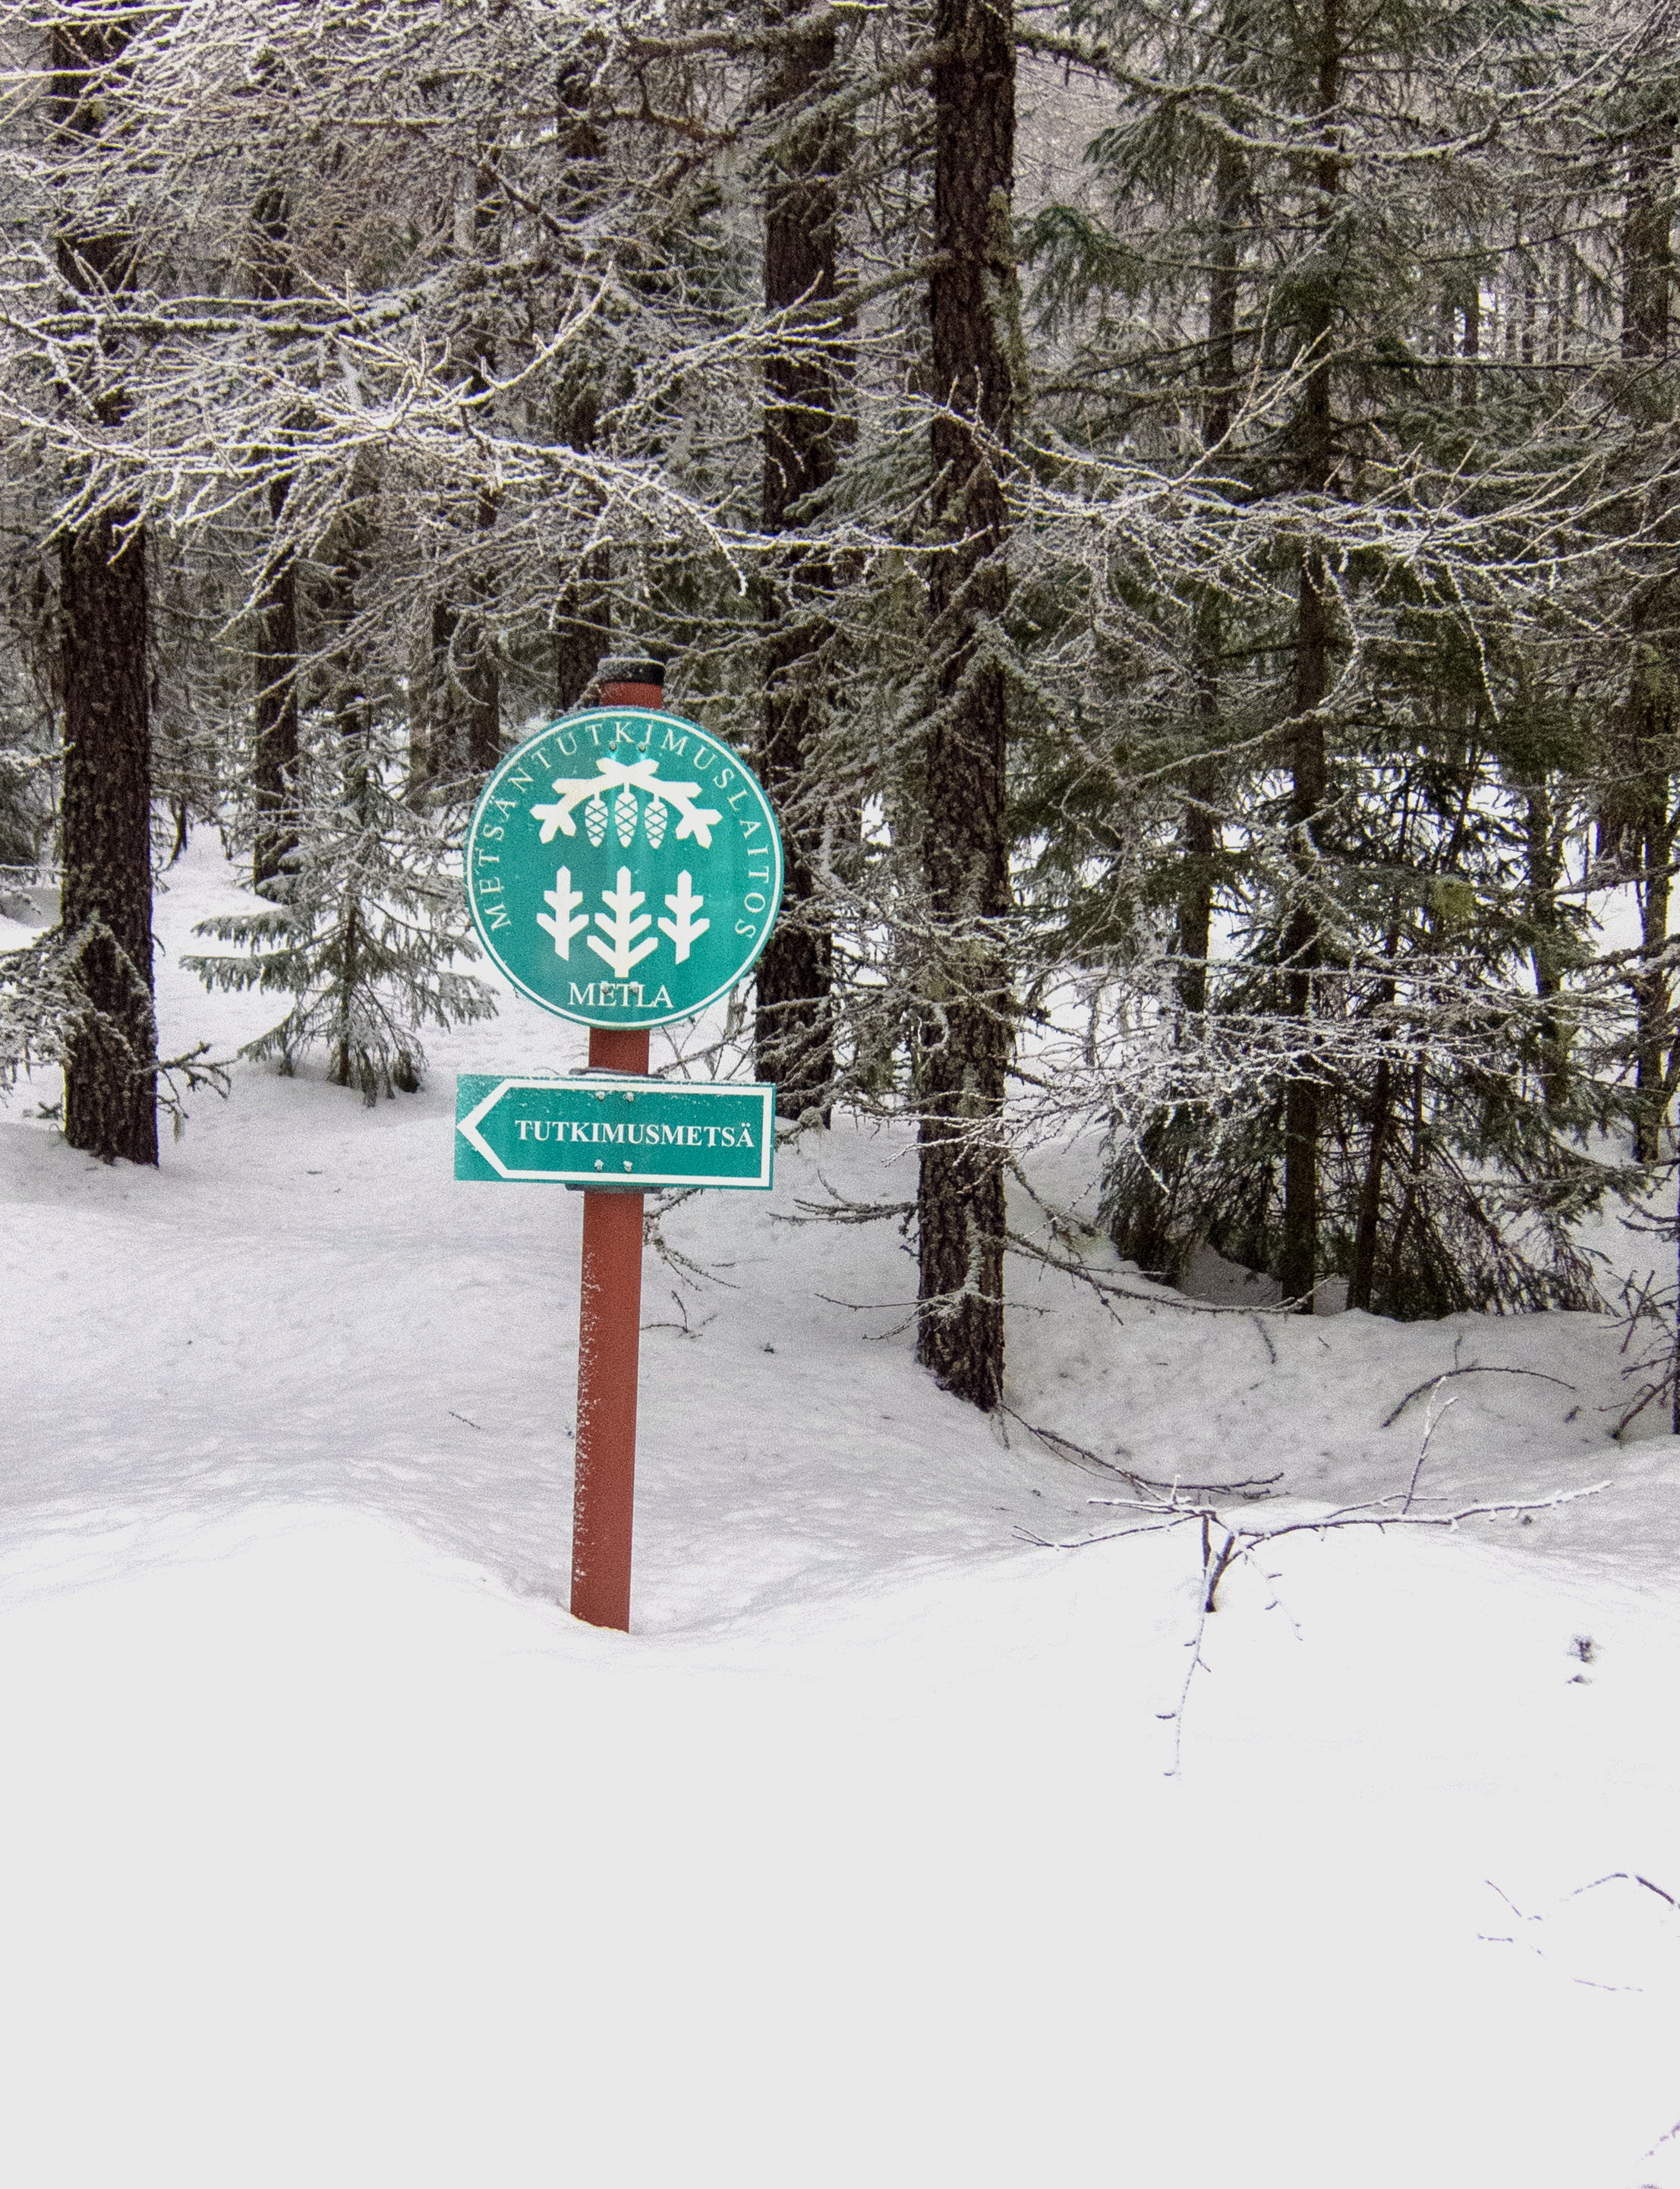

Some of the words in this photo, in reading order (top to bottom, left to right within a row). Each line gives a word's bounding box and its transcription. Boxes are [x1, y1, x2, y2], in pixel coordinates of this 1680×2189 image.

[478, 721, 769, 940] METSÄNTUTKIMUSLAITOS
[568, 982, 673, 1008] METLA
[515, 1120, 755, 1147] TUTKIMUSMETSÄ
